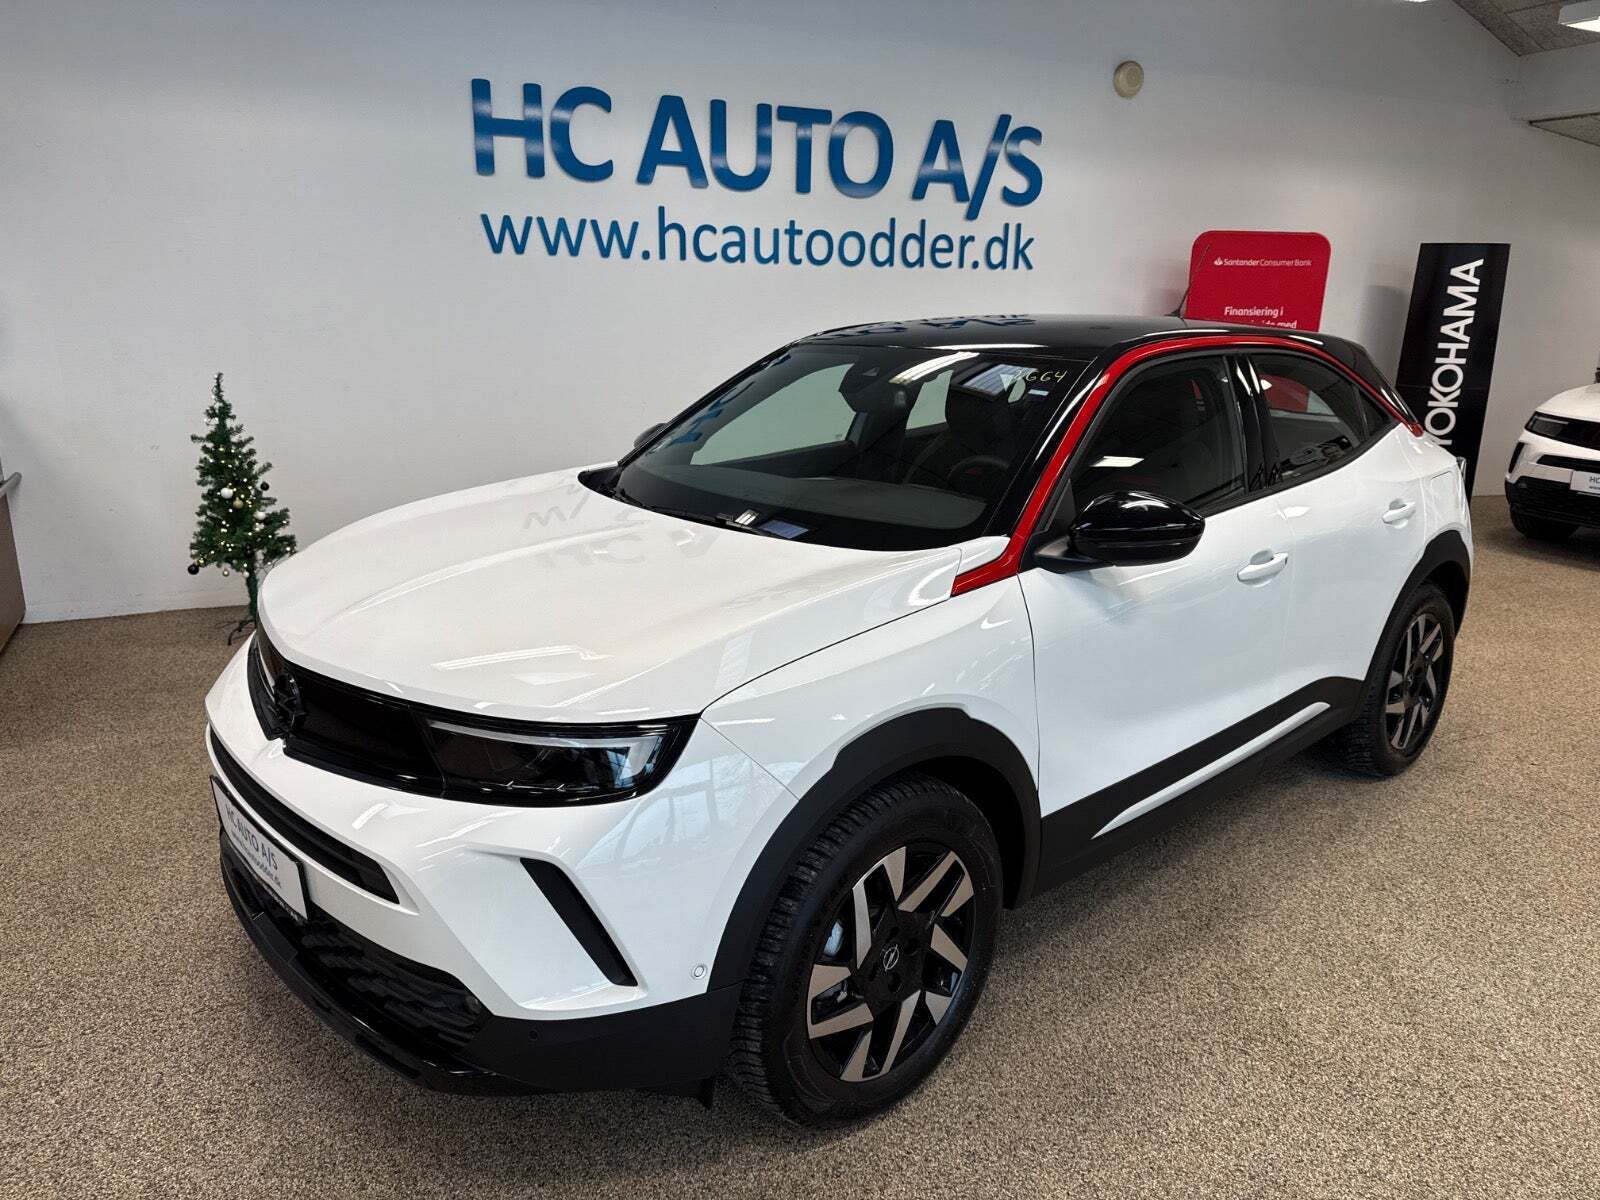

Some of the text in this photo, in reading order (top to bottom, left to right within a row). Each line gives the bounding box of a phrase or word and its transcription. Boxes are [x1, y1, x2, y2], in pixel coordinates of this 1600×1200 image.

[471, 78, 1043, 221] HC AUTO A/S
[480, 205, 1036, 271] www.hcautoodder.dk
[1223, 258, 1312, 267] Santander Consumer Bank
[1224, 306, 1279, 318] Finansiering
